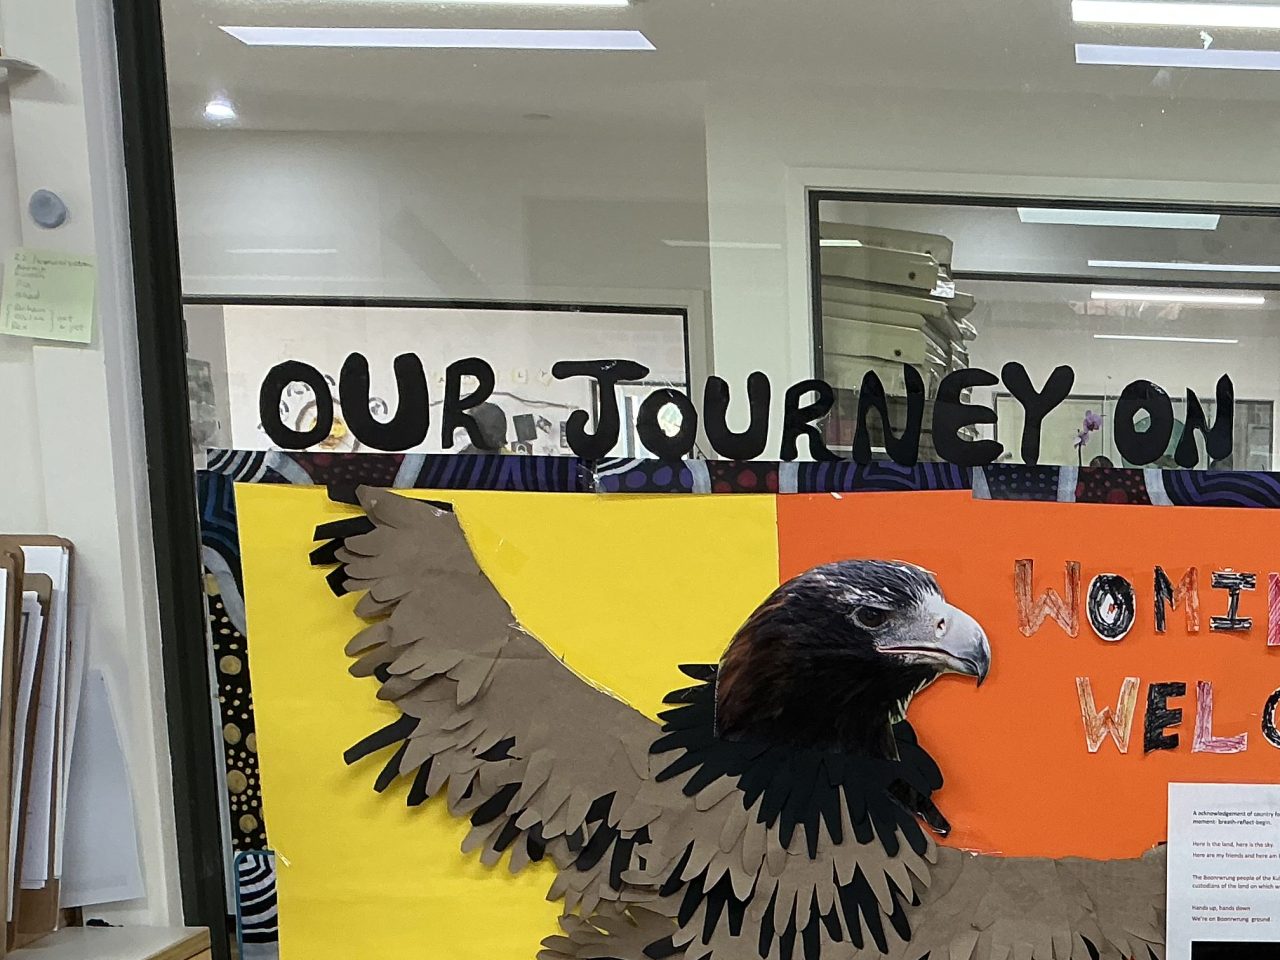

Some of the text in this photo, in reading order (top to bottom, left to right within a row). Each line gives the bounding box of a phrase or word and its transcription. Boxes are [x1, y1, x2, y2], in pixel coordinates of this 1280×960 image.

[259, 352, 497, 452] OUR
[551, 361, 1075, 468] JOURNEY
[1113, 373, 1234, 470] ON
